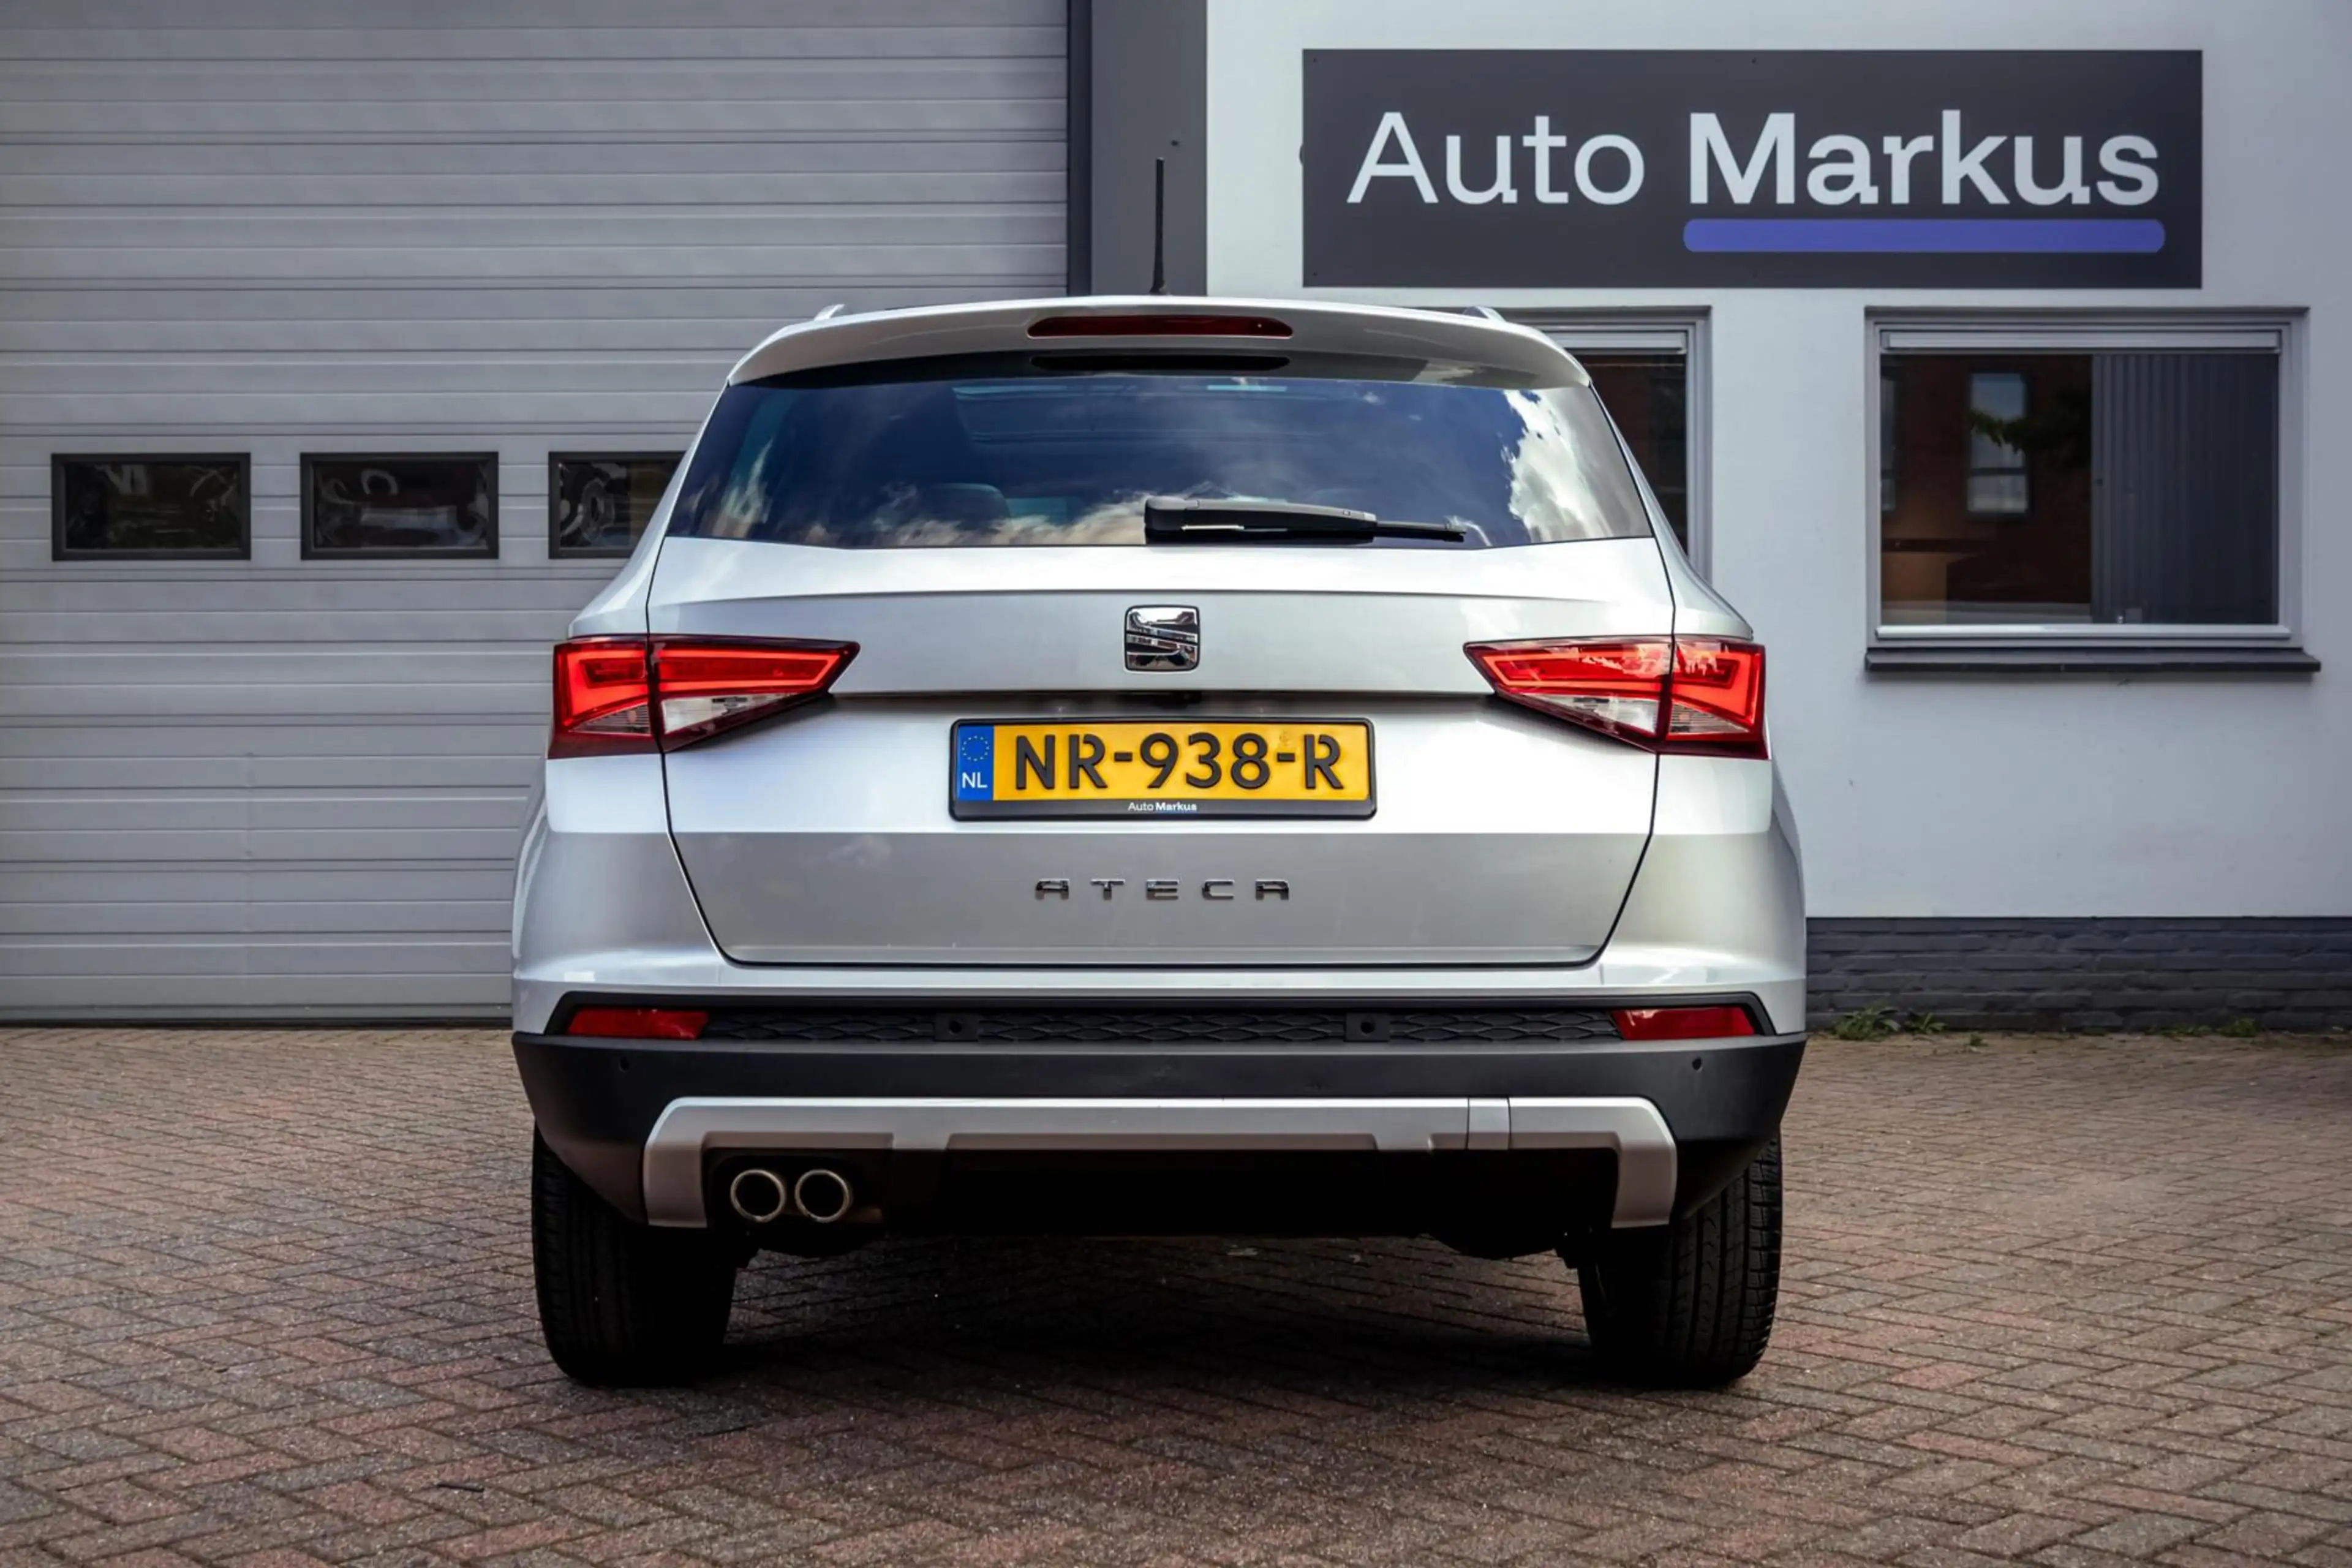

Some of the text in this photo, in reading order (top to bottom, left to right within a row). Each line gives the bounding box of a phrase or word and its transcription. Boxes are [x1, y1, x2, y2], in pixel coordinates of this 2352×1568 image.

[1347, 109, 2160, 205] Auto Markus
[1015, 733, 1344, 790] NR-938-R
[962, 772, 987, 789] NL
[1128, 801, 1197, 812] Auto Markus
[1035, 878, 1289, 900] ATECA
